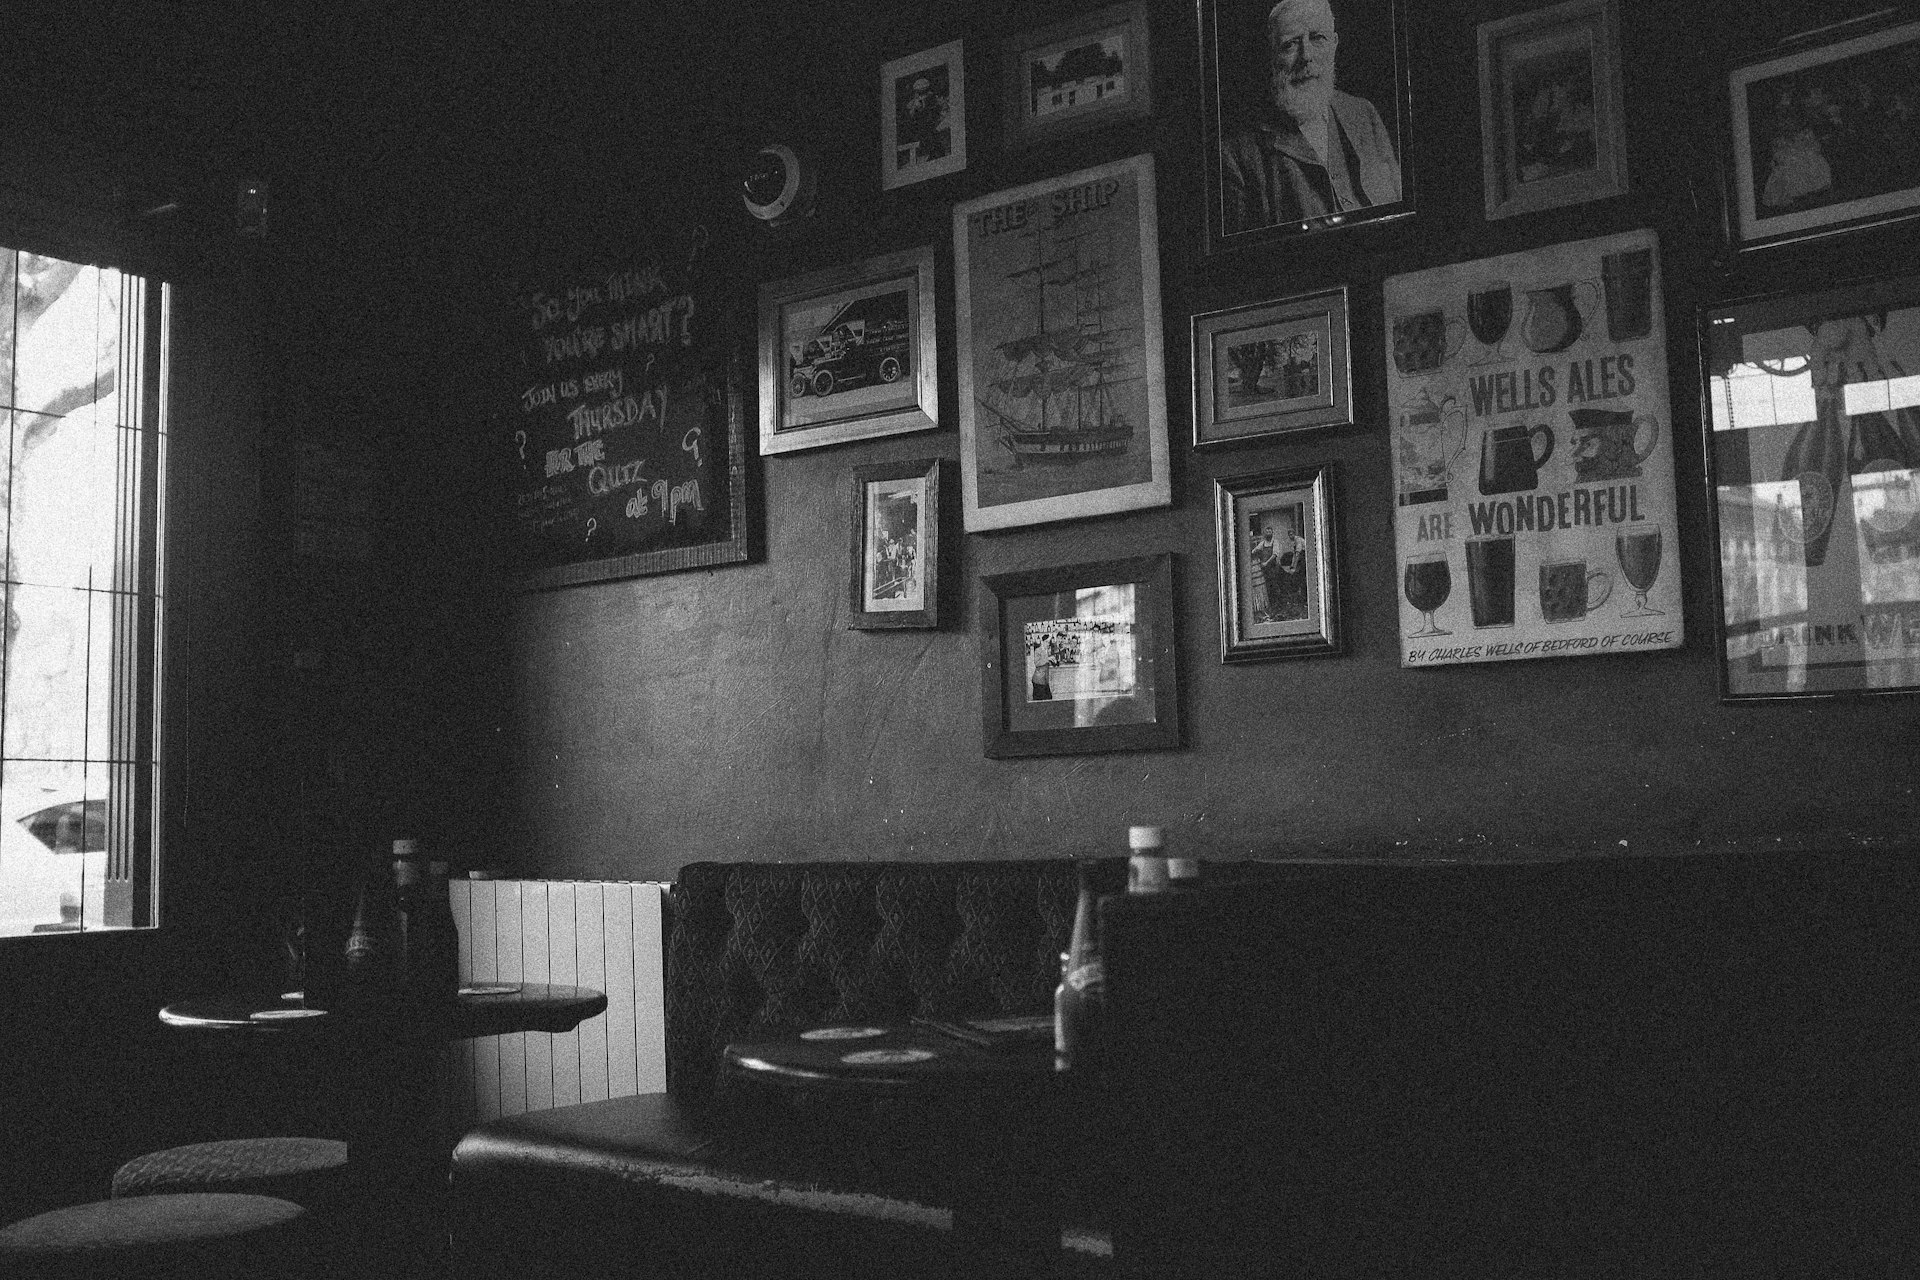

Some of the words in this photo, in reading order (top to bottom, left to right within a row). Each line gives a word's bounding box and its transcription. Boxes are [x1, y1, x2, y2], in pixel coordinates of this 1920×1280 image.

[971, 204, 1029, 238] THE
[1051, 177, 1119, 218] SHIP
[566, 382, 668, 441] THURSDAY
[1468, 365, 1556, 417] WELLS
[1566, 353, 1636, 406] ALES
[588, 459, 648, 497] QUIZ
[625, 487, 649, 518] at
[1416, 511, 1455, 543] ARE
[1468, 484, 1646, 536] WONDERFUL
[1408, 650, 1425, 664] BY
[1428, 645, 1482, 662] CHARLES
[1485, 641, 1524, 658] WELLS
[1523, 640, 1541, 654] OF
[1541, 635, 1599, 653] BEDFORD
[1601, 633, 1621, 649] OF
[1621, 630, 1676, 647] COURSE
